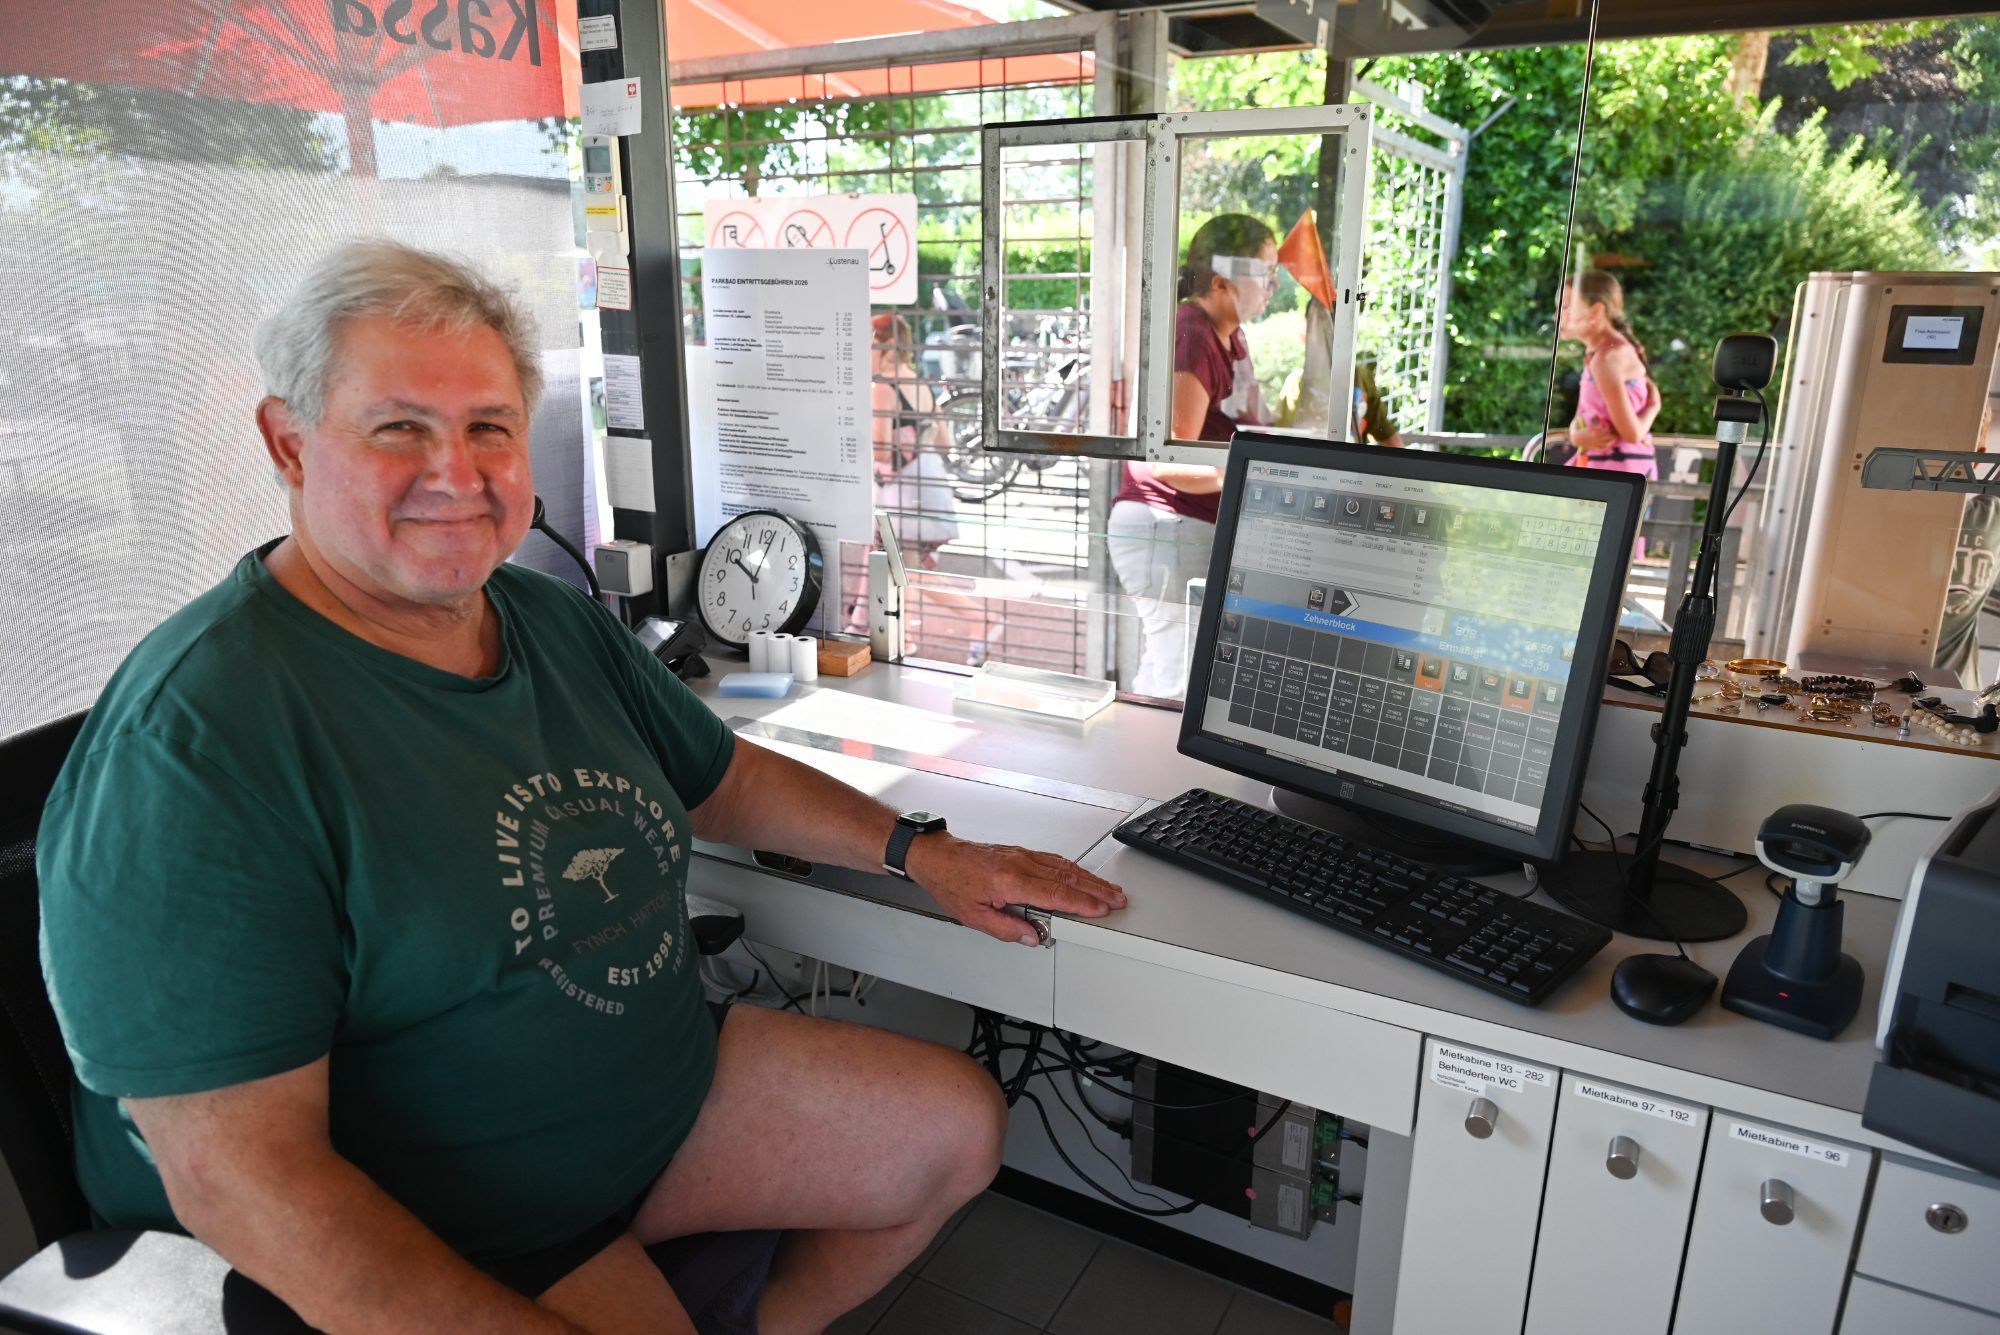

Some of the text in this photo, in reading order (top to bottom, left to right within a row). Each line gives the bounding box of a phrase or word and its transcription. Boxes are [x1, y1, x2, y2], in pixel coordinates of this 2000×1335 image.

[827, 257, 860, 266] Lustenau
[737, 278, 794, 286] EINTRITTSGEBÜHREN
[1252, 466, 1300, 479] AXESS
[742, 534, 752, 549] 11
[780, 537, 786, 553] 1
[725, 548, 742, 564] 10
[788, 555, 798, 571] 2
[716, 569, 727, 583] 9
[790, 577, 799, 592] 3
[716, 591, 726, 607] 8
[779, 600, 788, 614] 4
[728, 609, 737, 624] 7
[762, 613, 771, 628] 5
[1303, 612, 1357, 632] Zehnerblock
[742, 618, 752, 632] 6
[1455, 626, 1478, 639] EUR
[573, 768, 681, 864] EXPLORE
[496, 811, 525, 886] LIVE
[529, 797, 669, 941] PREMIUM CASUAL WEAR
[572, 889, 672, 954] FYNCH HATTON
[510, 907, 532, 956] TO
[607, 931, 673, 986] EST 1998
[538, 957, 625, 1016] REGISTERED
[1439, 1047, 1492, 1068] Mietkabine
[1495, 1062, 1513, 1074] 193
[1524, 1070, 1544, 1082] 282
[1438, 1060, 1496, 1083] Behinderten
[1498, 1076, 1518, 1088] WC
[1581, 1085, 1639, 1108] Mietkabine
[1641, 1101, 1656, 1112] 97
[1669, 1109, 1690, 1122] 192
[1737, 1127, 1800, 1151] Mietkabine
[1803, 1145, 1809, 1153] 1
[1824, 1150, 1841, 1162] 96
